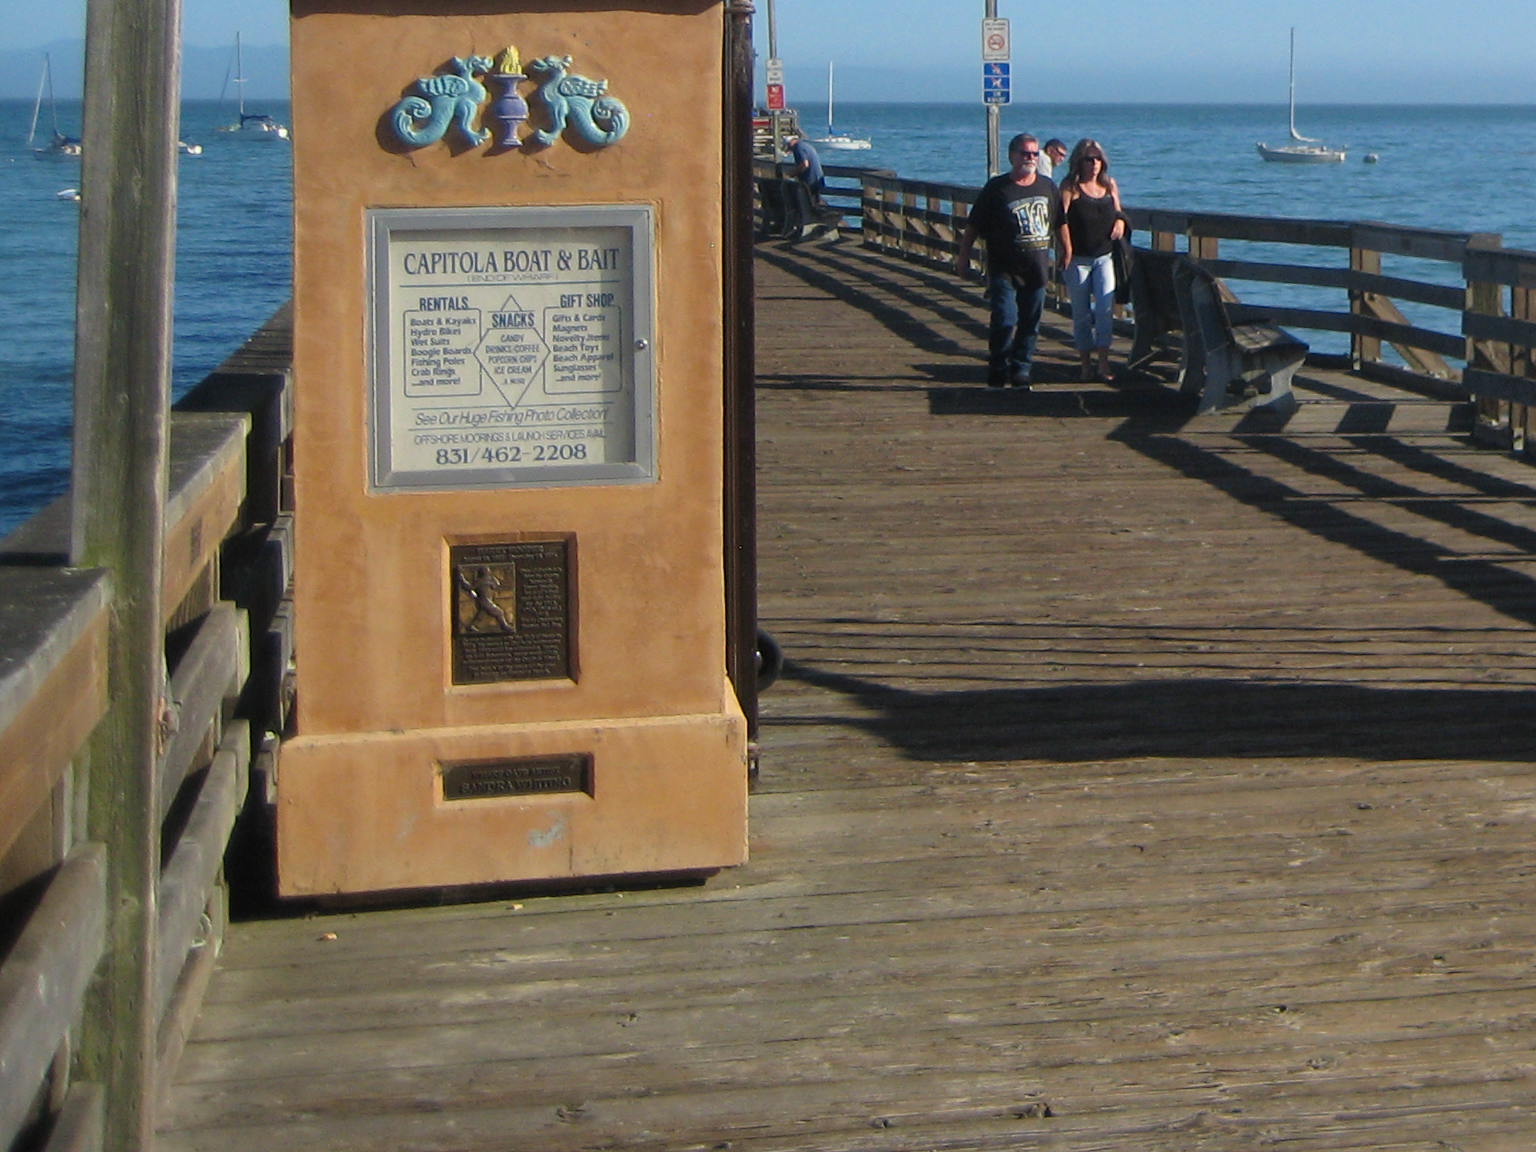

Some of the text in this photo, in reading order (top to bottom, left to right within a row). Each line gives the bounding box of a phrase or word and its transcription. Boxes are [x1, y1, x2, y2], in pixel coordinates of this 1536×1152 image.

[404, 248, 620, 275] CAPITOLA BOAT & BAIT
[420, 296, 469, 311] RENTALS
[560, 293, 614, 308] GIFT SHOP
[410, 318, 433, 326] Boats
[445, 317, 476, 327] Kayaks
[491, 312, 535, 328] SNACKS
[552, 313, 606, 322] Gifts & Cards
[410, 328, 437, 337] Hydro
[552, 325, 588, 333] Magnets
[430, 337, 449, 345] Suits
[501, 334, 524, 342] CANDY
[552, 335, 585, 343] Novelty
[411, 347, 471, 358] Boogie Boards
[553, 343, 599, 353] Beach Toys
[553, 352, 614, 362] Beach Apparel
[411, 357, 465, 368] Fishing Poles
[411, 368, 431, 376] Crab
[495, 366, 532, 374] ICE CREAM
[554, 364, 597, 373] Sunglasses
[416, 412, 437, 426] See
[439, 411, 458, 424] Our
[460, 411, 487, 427] Huge
[488, 409, 525, 426] Fishing
[525, 408, 555, 421] Photo
[415, 434, 459, 445] OFFSHORE
[460, 432, 504, 443] MOORINGS
[512, 431, 543, 441] LAUNCH
[544, 429, 585, 440] SERVICES
[436, 444, 586, 465] 831/462-2208
